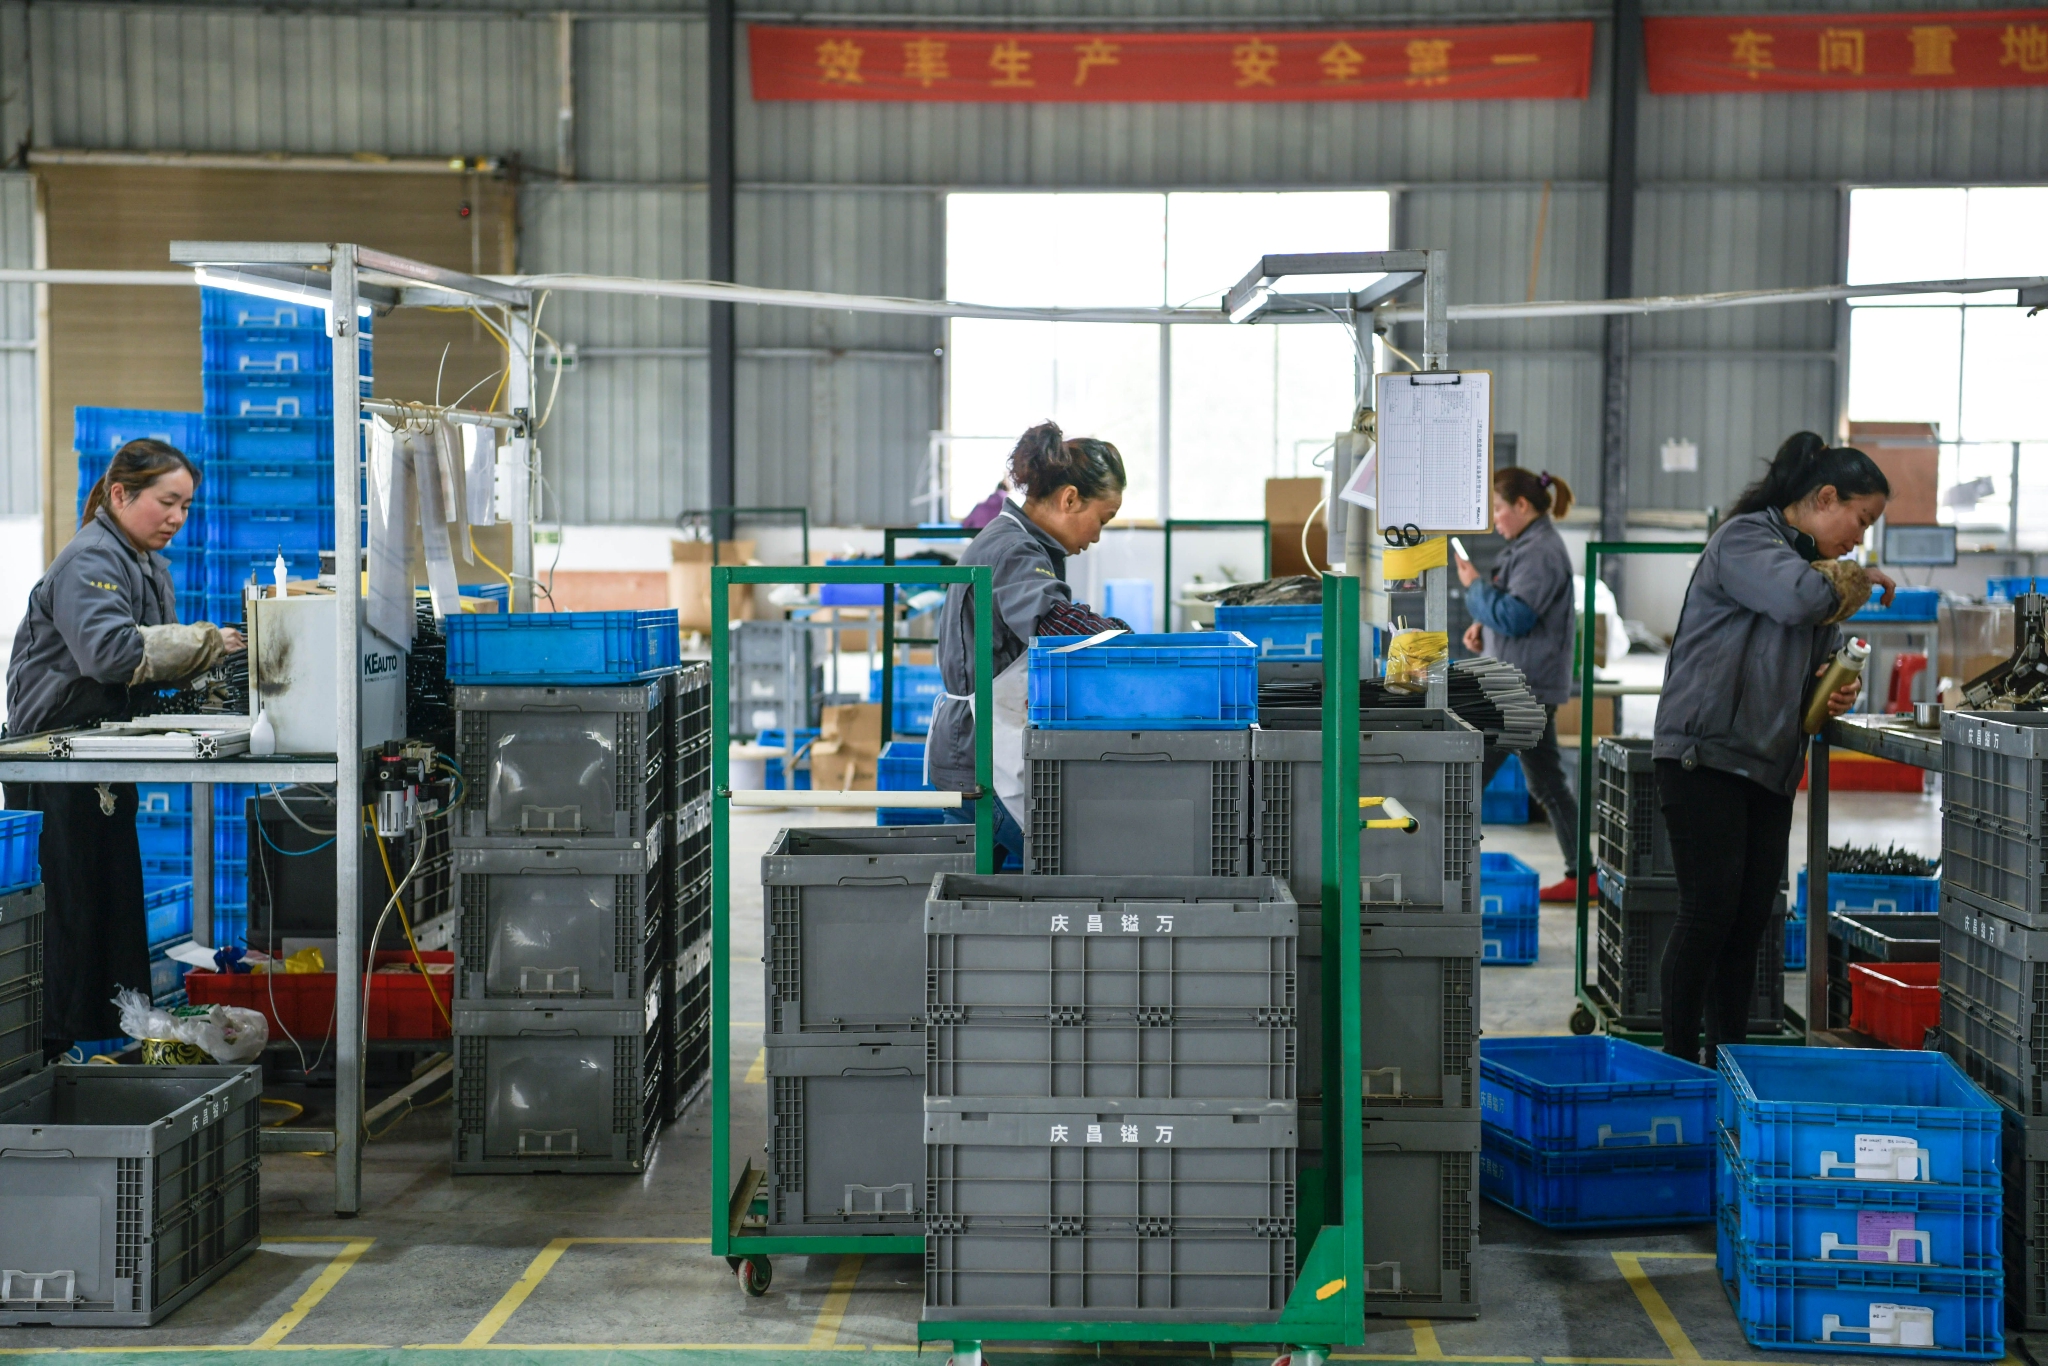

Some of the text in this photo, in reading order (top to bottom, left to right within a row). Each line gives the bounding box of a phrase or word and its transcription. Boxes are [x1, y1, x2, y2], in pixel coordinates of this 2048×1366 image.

[816, 38, 1541, 88] 效率生产 安全第一
[1728, 24, 2048, 79] 车间重地
[1050, 914, 1175, 933] 庆昌镒万
[1050, 1124, 1175, 1144] 庆昌镒万
